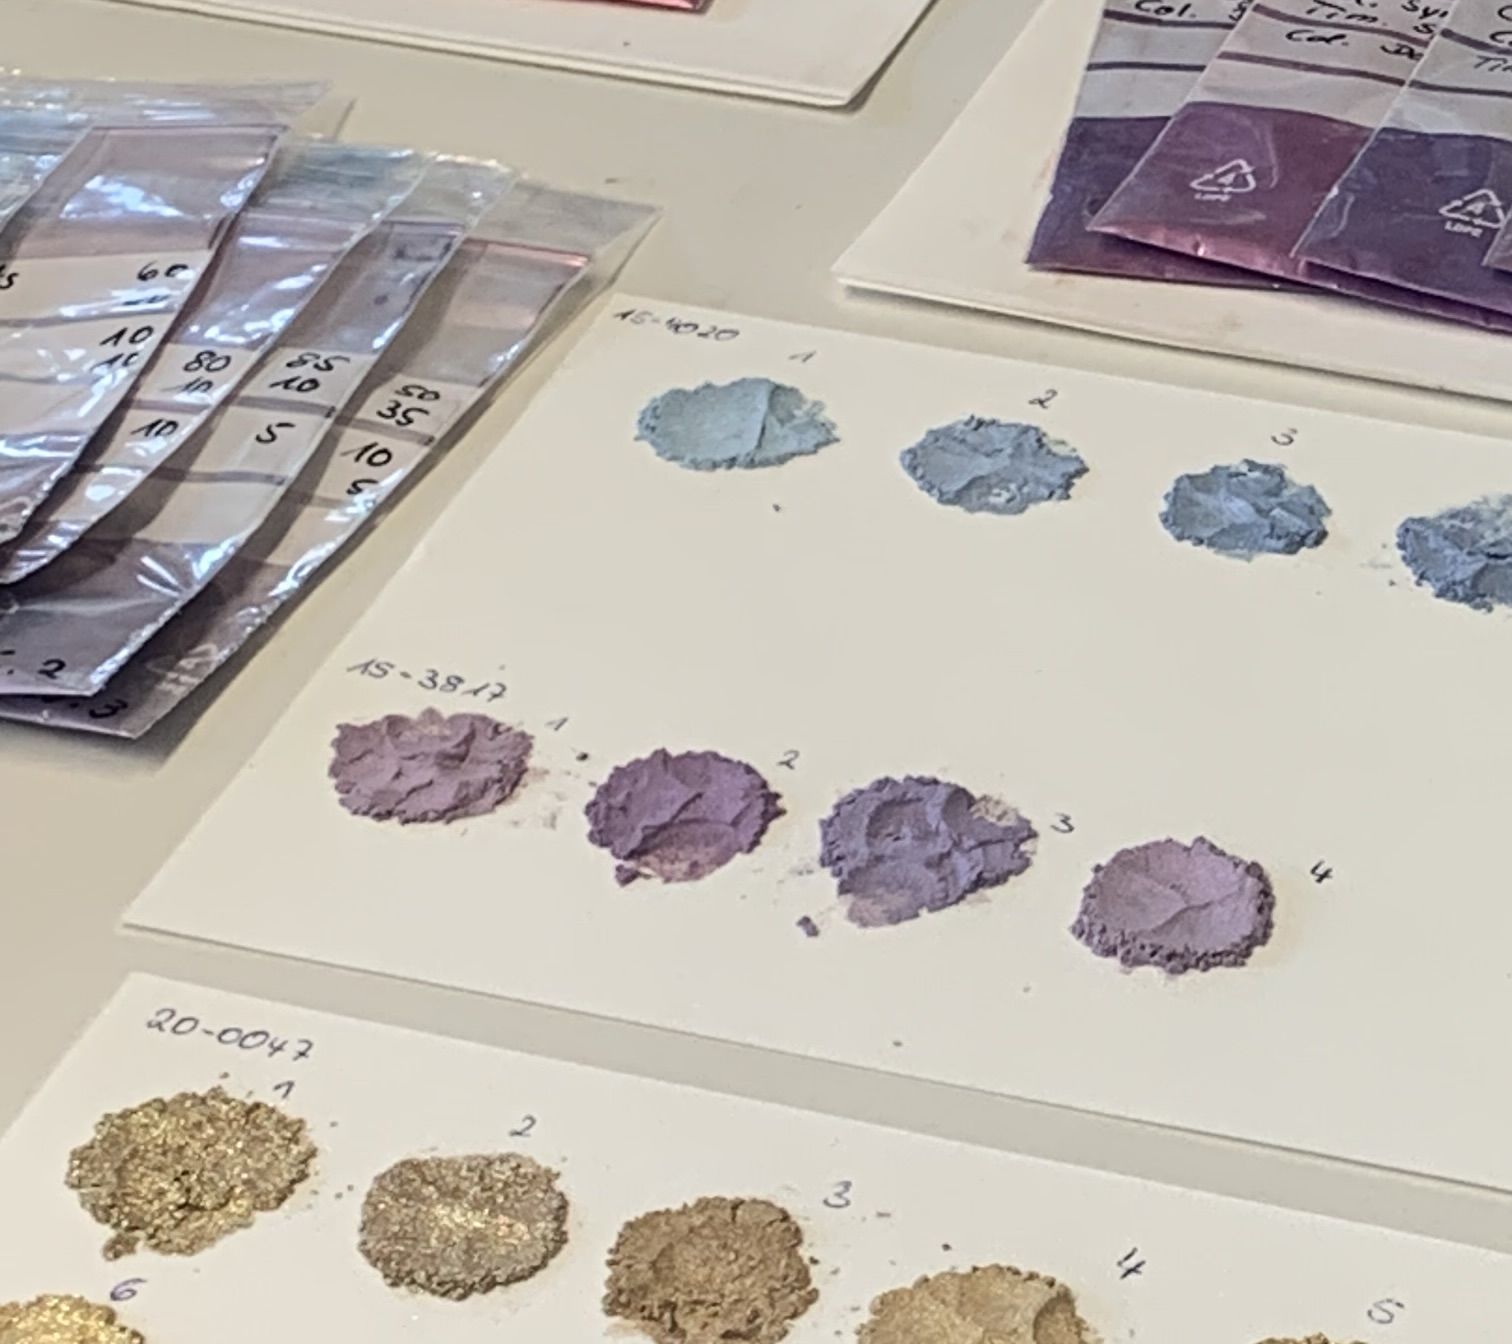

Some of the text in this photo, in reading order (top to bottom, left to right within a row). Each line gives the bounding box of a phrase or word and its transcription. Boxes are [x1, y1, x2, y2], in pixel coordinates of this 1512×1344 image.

[100, 325, 154, 347] 10
[612, 308, 740, 342] 15-4020
[182, 349, 232, 373] 80
[285, 351, 351, 372] 85
[268, 375, 320, 393] 10
[394, 384, 441, 401] 50
[376, 399, 430, 427] 35
[1028, 388, 1058, 409] 2
[1270, 428, 1298, 446] 3
[130, 418, 179, 437] 10
[255, 421, 296, 444] 5
[339, 441, 393, 467] 10
[346, 478, 380, 496] 5
[37, 657, 67, 680] 2
[346, 657, 508, 702] 15-3817
[88, 698, 129, 720] 3
[776, 749, 800, 770] 2
[1050, 812, 1075, 834] 3
[1309, 859, 1334, 885] 4
[146, 1008, 314, 1061] 20-0047
[272, 1080, 1406, 1325] 1 2 3 4 5
[109, 1278, 149, 1303] 6
